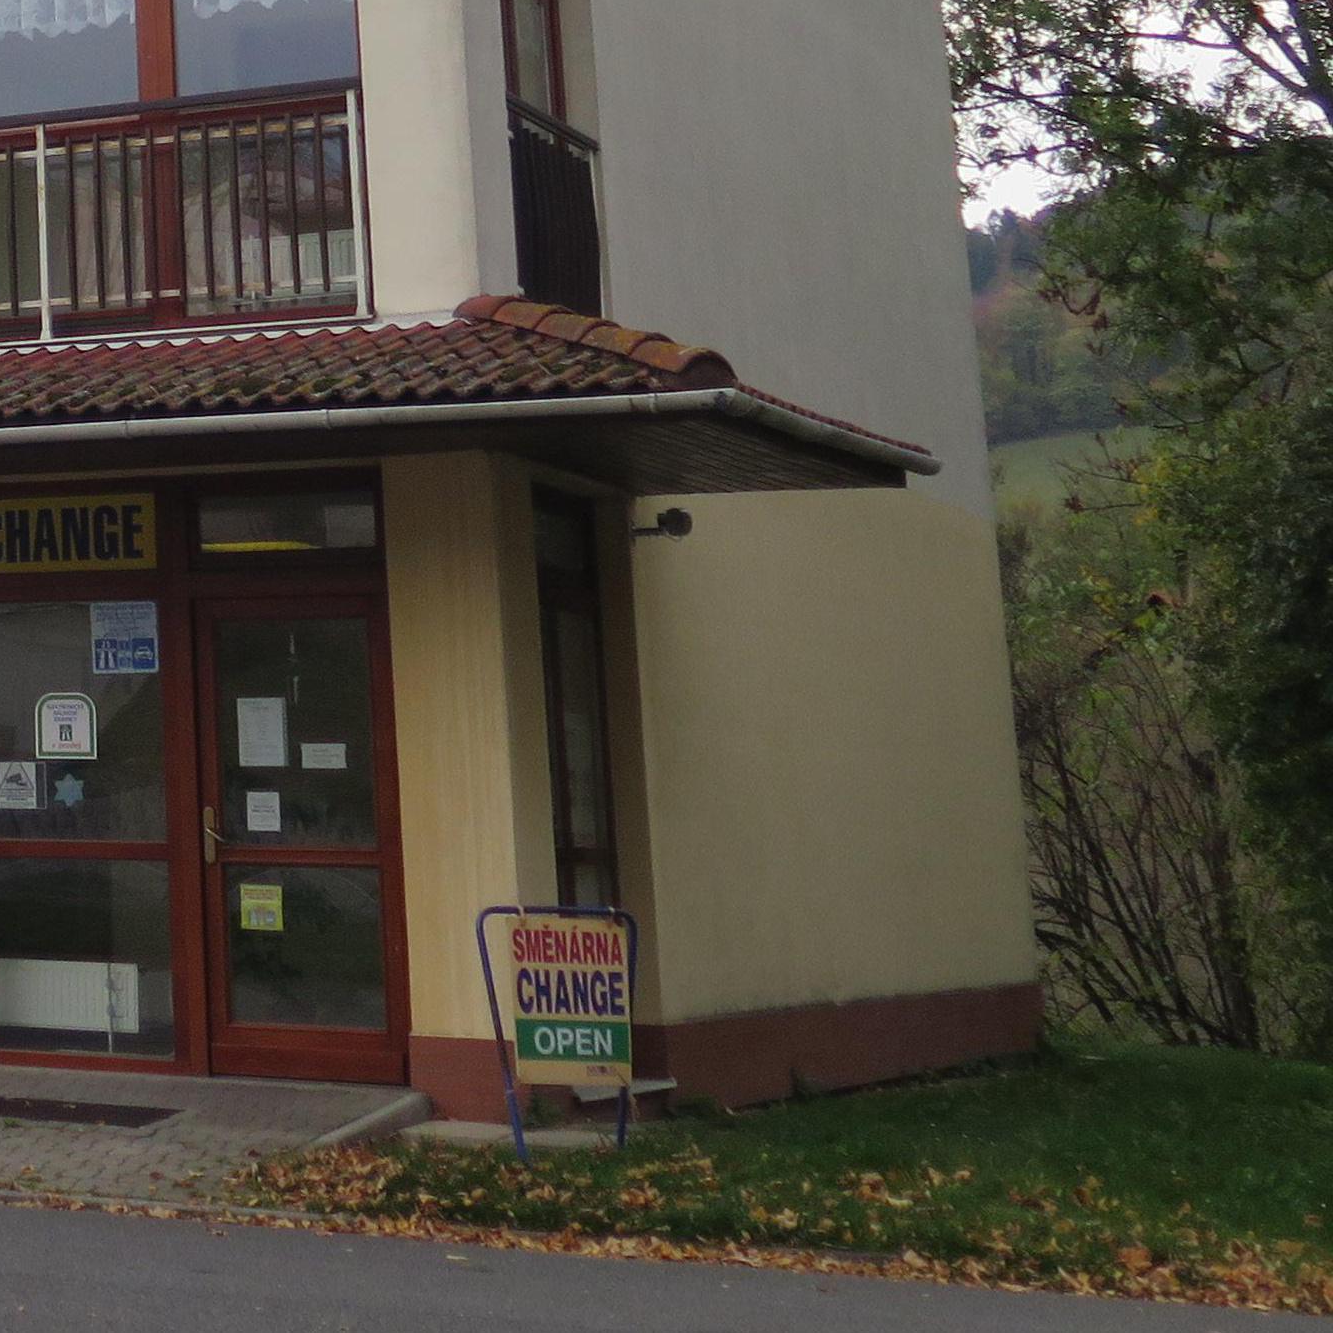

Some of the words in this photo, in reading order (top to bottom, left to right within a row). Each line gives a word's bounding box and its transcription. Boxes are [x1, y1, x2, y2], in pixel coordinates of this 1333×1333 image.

[513, 924, 623, 966] SMĚNÁRNA
[517, 968, 625, 1015] CHANGE
[535, 1027, 613, 1056] OPEN
